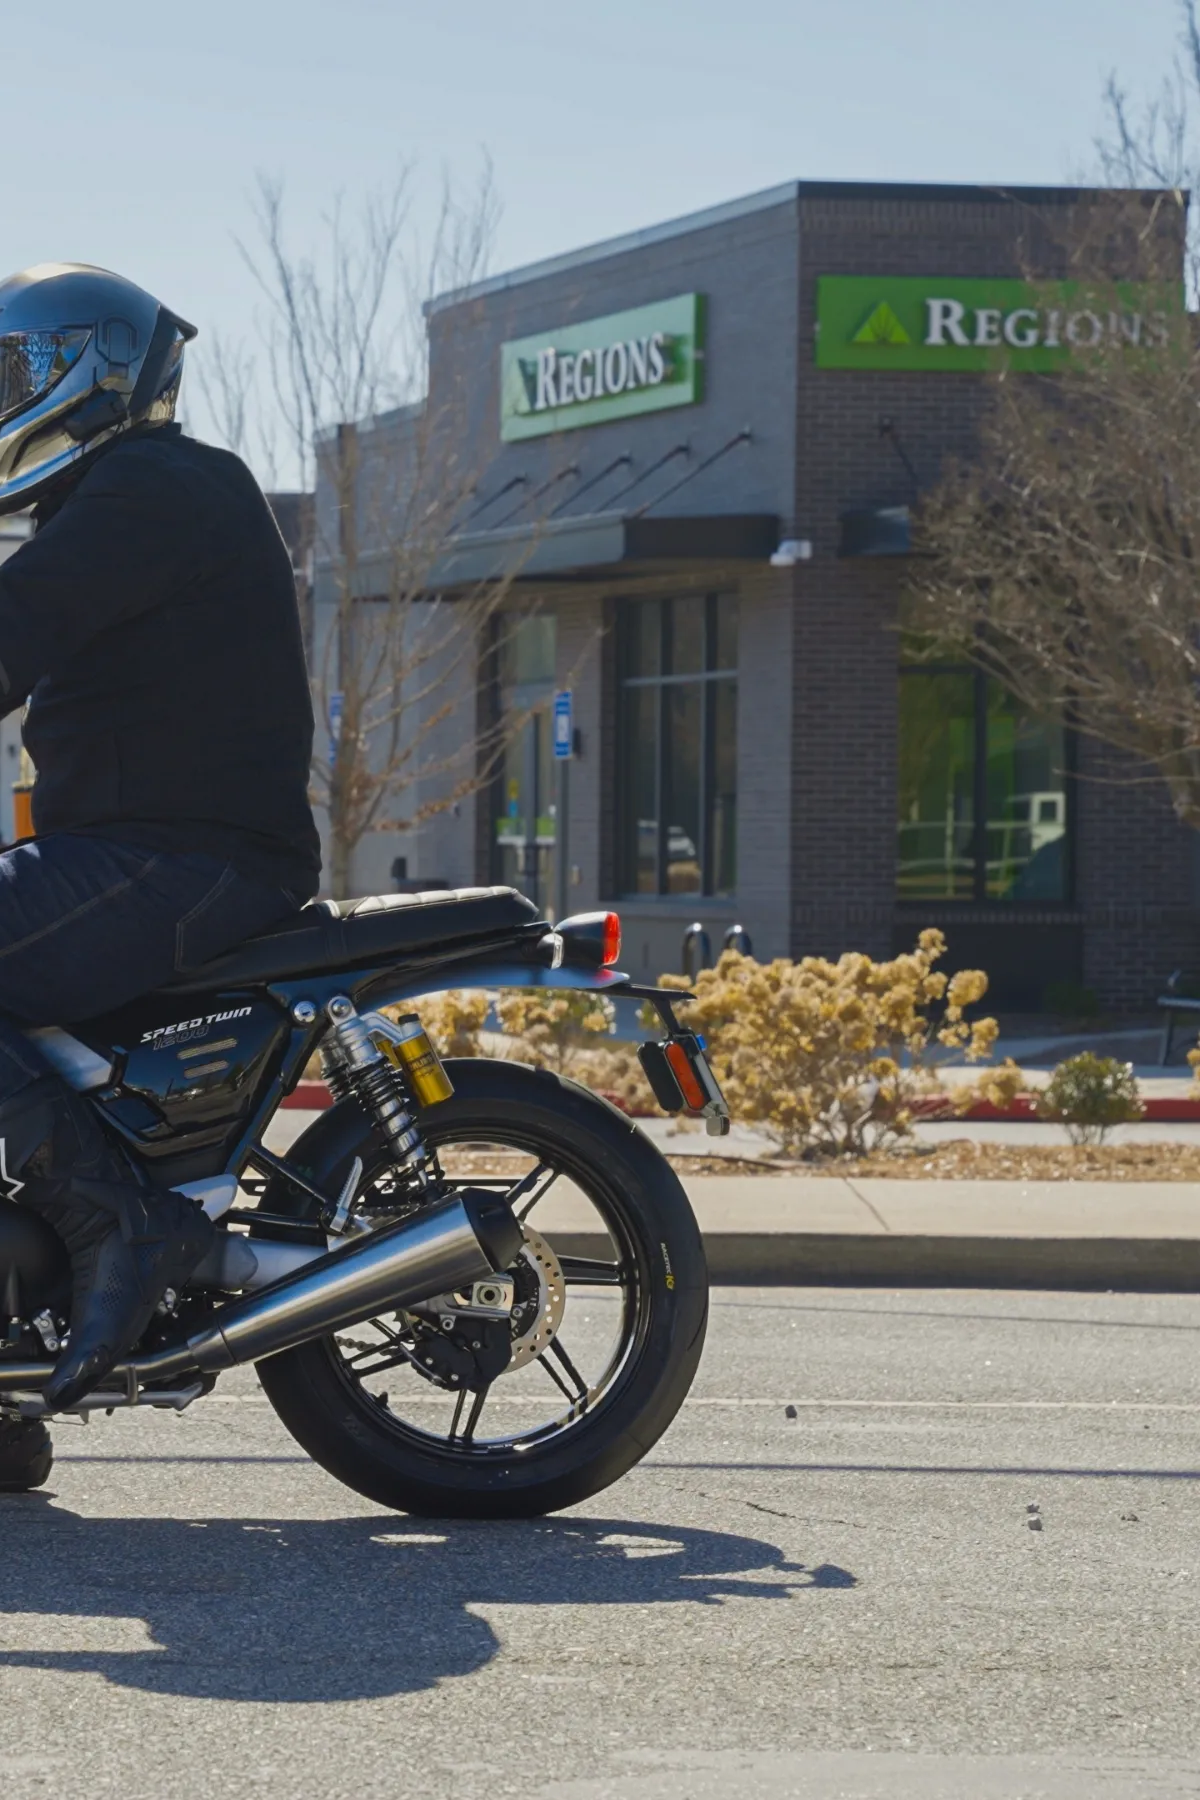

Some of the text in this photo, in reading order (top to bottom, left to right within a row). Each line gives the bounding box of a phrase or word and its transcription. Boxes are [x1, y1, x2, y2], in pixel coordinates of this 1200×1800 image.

[924, 297, 1169, 347] REGIONS
[534, 331, 664, 410] REGIONS
[140, 1006, 252, 1043] SPEED TWIN
[152, 1025, 209, 1050] 1200
[660, 1242, 672, 1275] RACETEC
